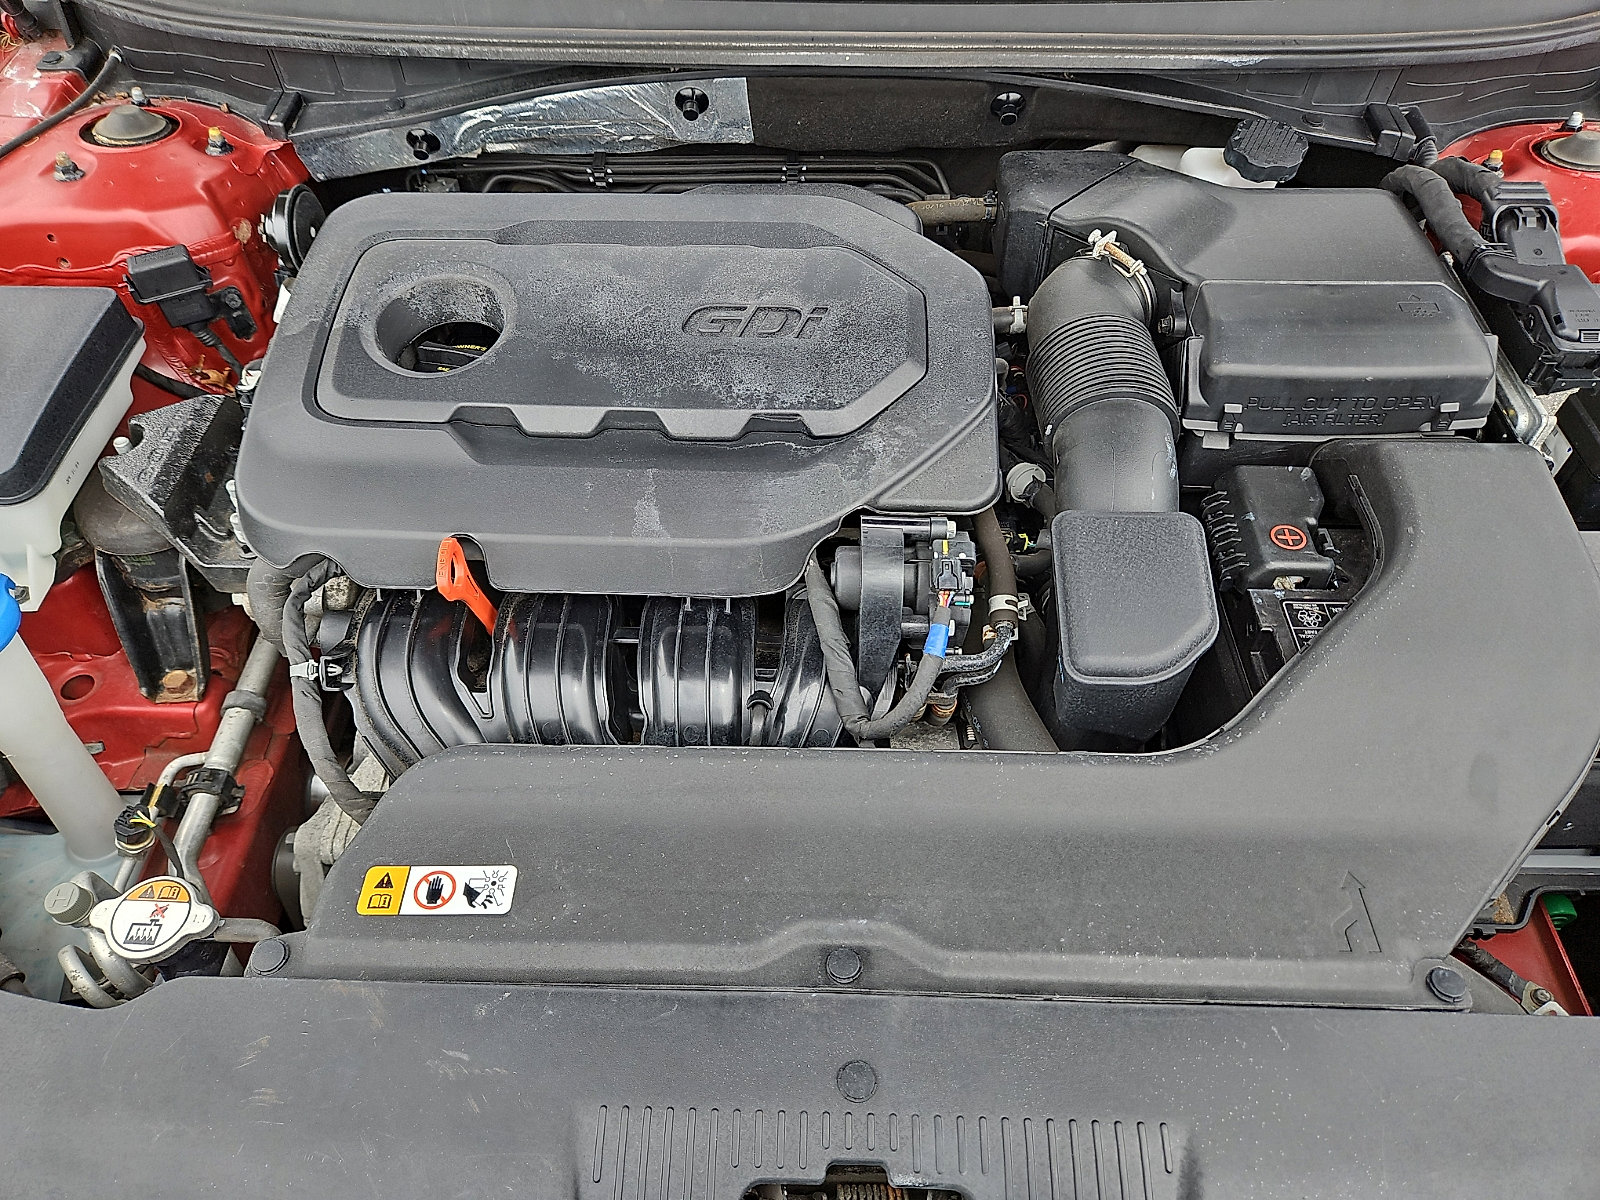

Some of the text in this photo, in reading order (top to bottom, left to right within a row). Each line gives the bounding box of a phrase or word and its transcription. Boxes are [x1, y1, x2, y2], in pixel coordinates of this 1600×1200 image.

[682, 303, 829, 338] GDi
[1245, 396, 1442, 411] PULL OUT TO OPEN
